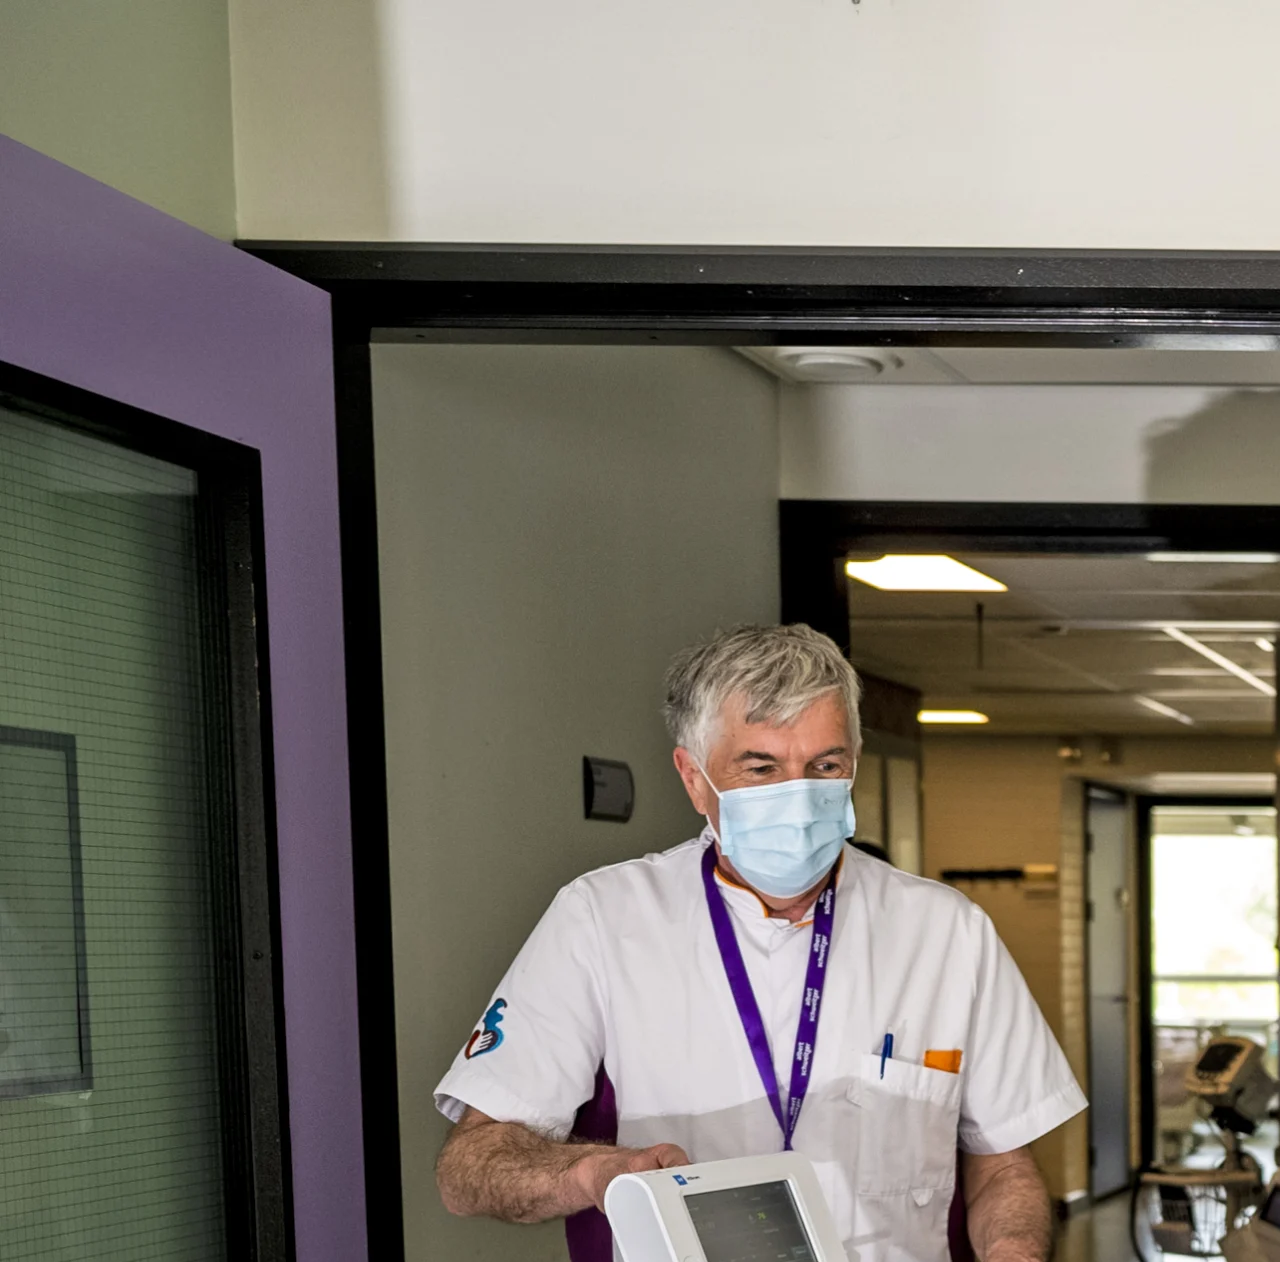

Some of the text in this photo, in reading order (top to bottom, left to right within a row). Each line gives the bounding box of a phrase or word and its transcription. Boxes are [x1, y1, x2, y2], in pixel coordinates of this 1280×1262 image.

[813, 933, 821, 953] albert
[817, 934, 828, 968] schweitzer
[805, 987, 813, 1006] albert
[809, 988, 820, 1021] schweitzer
[796, 1042, 805, 1060] albert
[801, 1043, 811, 1076] schweitzer
